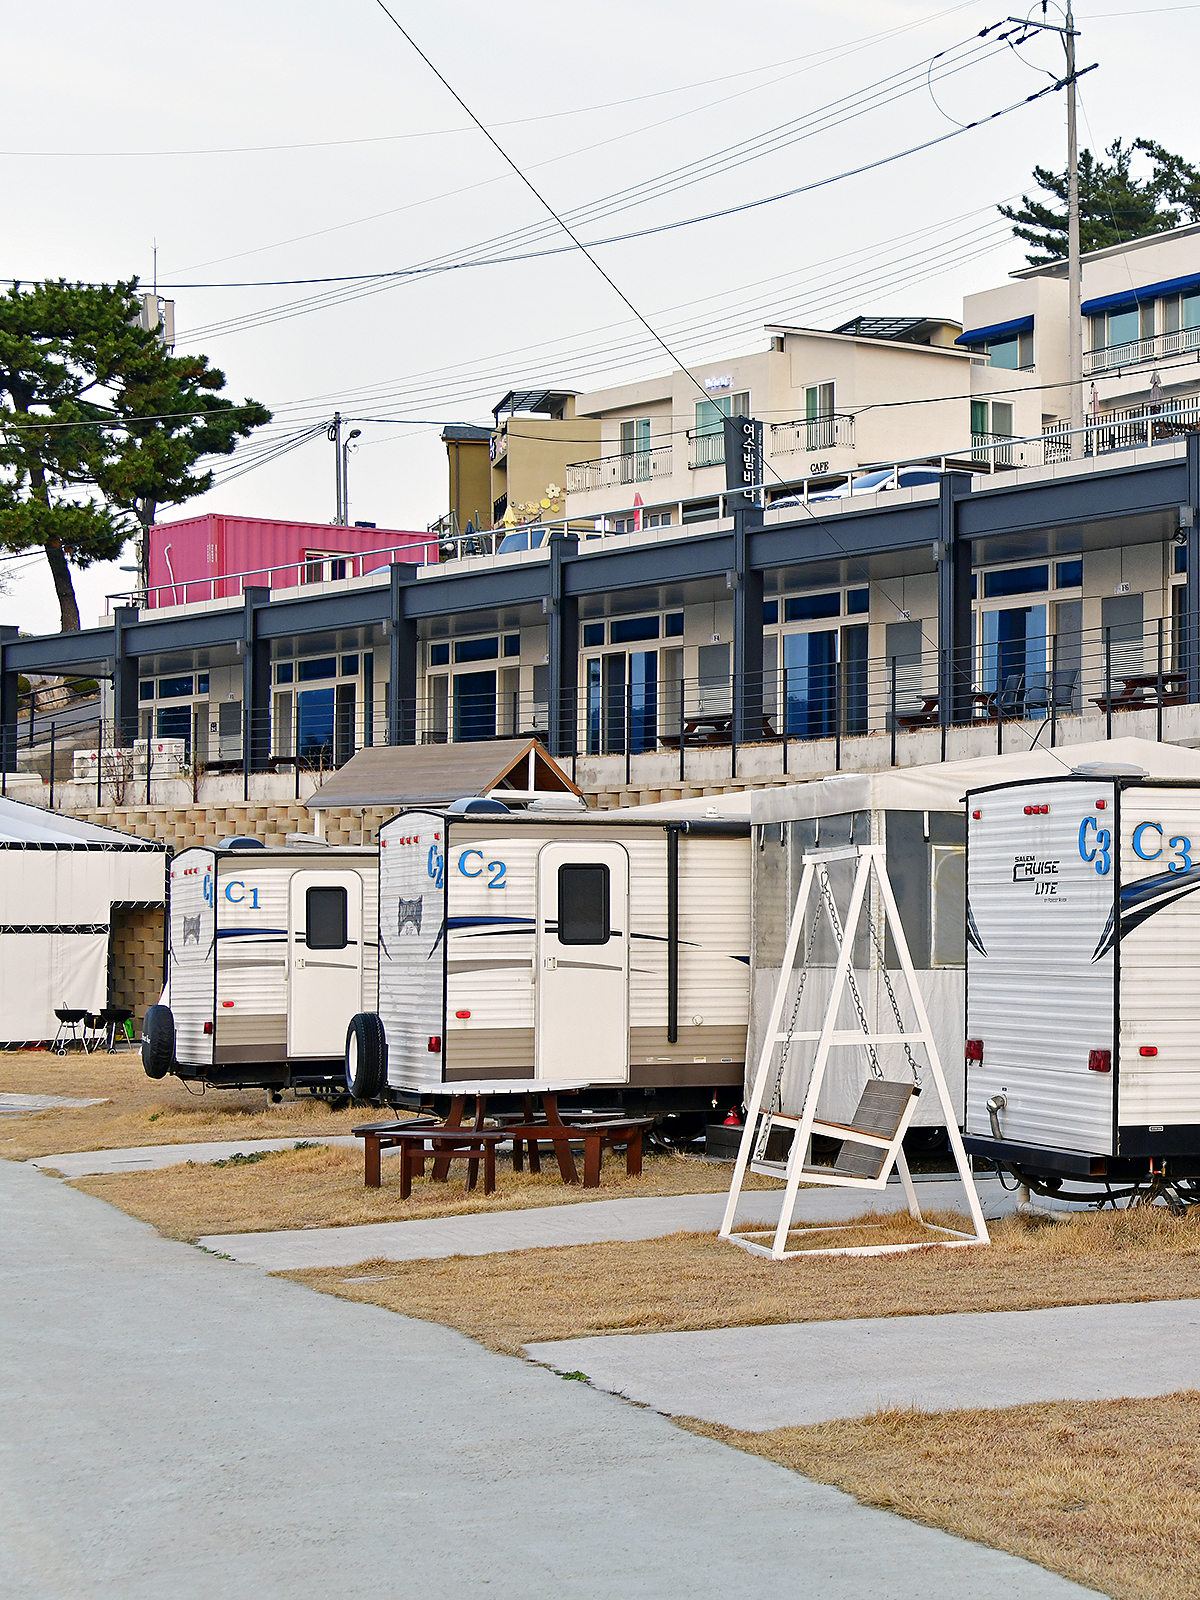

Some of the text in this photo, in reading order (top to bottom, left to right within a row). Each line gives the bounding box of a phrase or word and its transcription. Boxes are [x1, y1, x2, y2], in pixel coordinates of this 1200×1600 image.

[743, 423, 756, 503] 여수밤바다
[810, 461, 829, 473] CAFE
[1014, 855, 1036, 863] SALEM
[1078, 816, 1112, 875] C3
[1131, 821, 1192, 874] C3
[427, 844, 444, 889] C2
[458, 849, 507, 889] C2
[1012, 860, 1060, 882] CRUISE
[225, 881, 261, 909] C1
[1034, 882, 1059, 896] LITE
